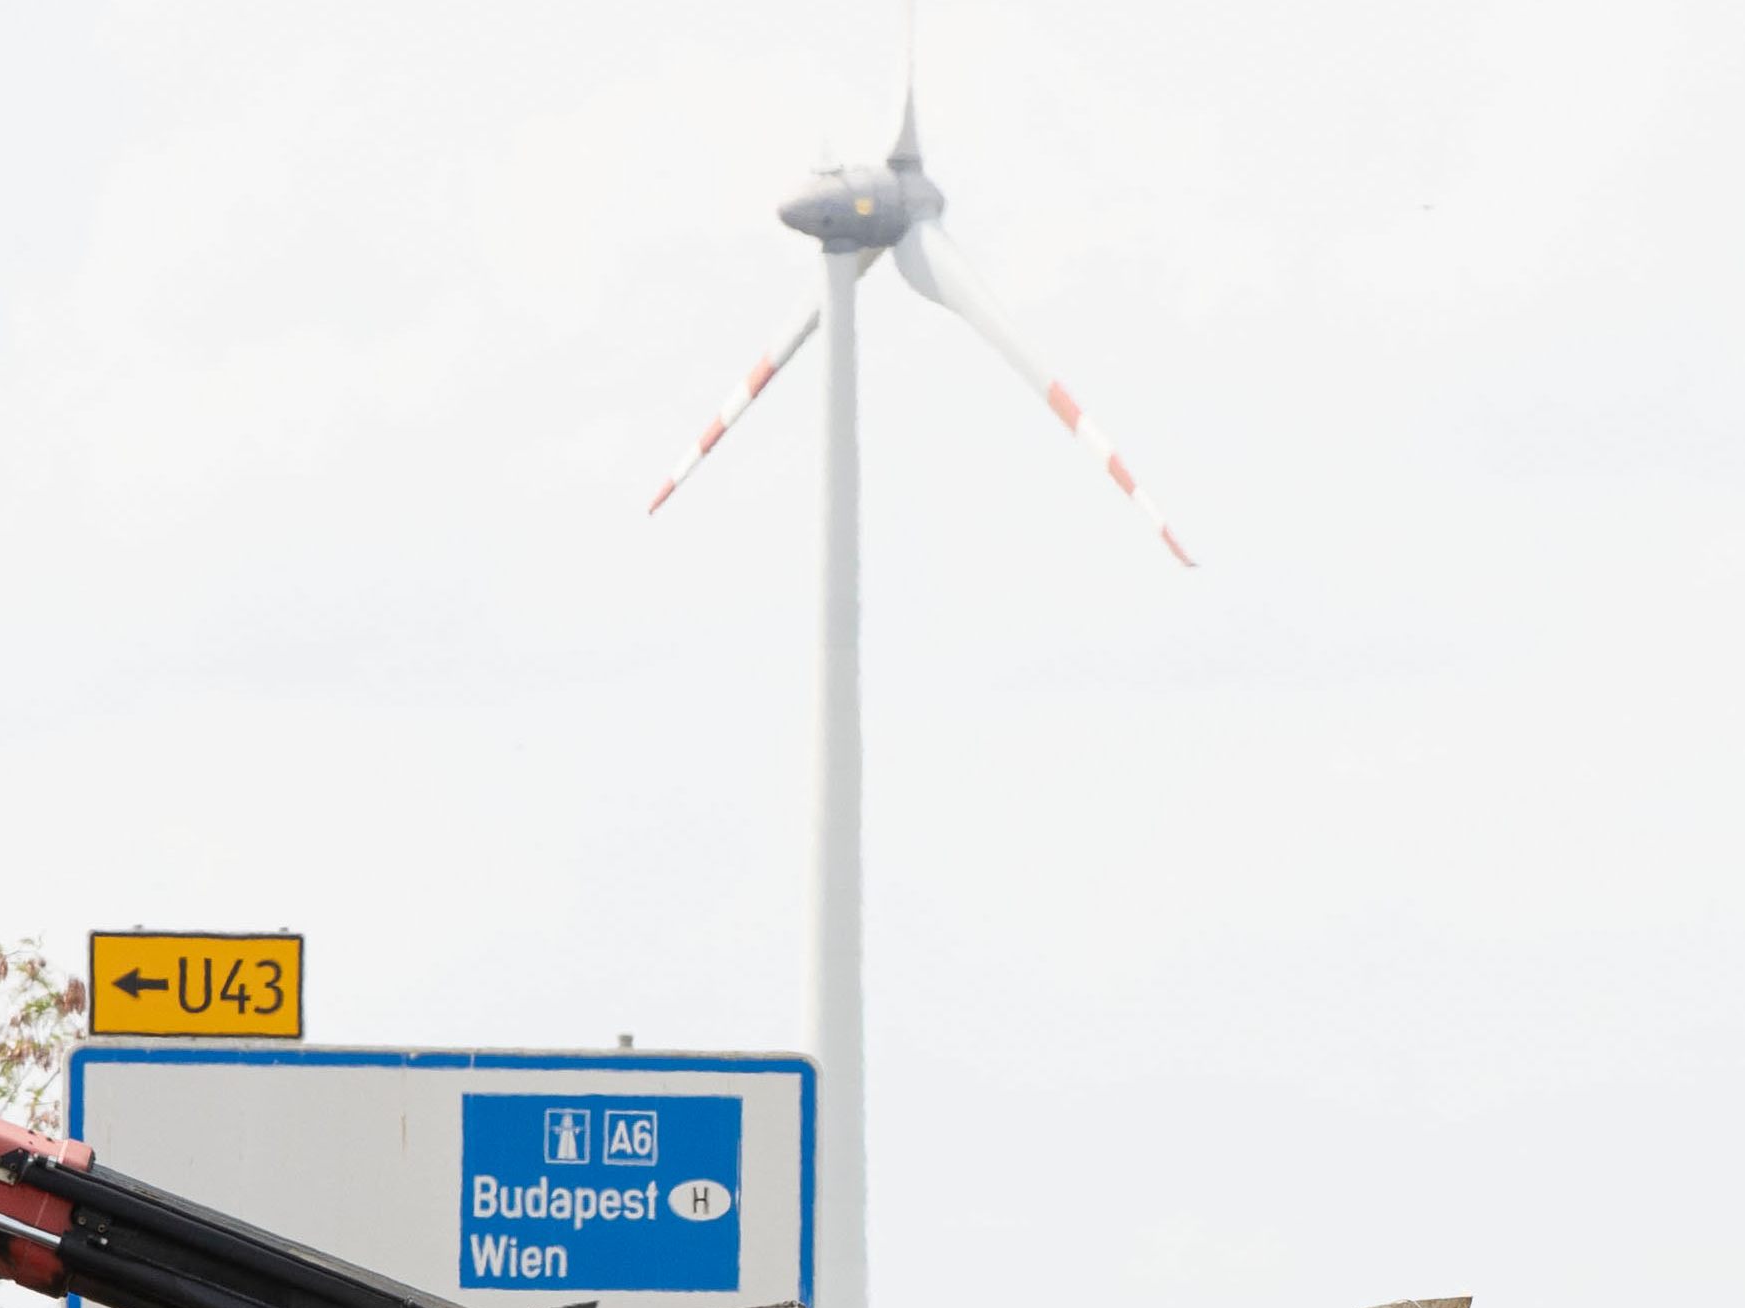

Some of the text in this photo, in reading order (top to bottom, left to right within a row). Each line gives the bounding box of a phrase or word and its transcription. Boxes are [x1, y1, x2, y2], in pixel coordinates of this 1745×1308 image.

[178, 956, 284, 1015] U43
[609, 1119, 652, 1156] A6
[472, 1175, 709, 1230] Budapest H
[469, 1233, 568, 1279] Wien
